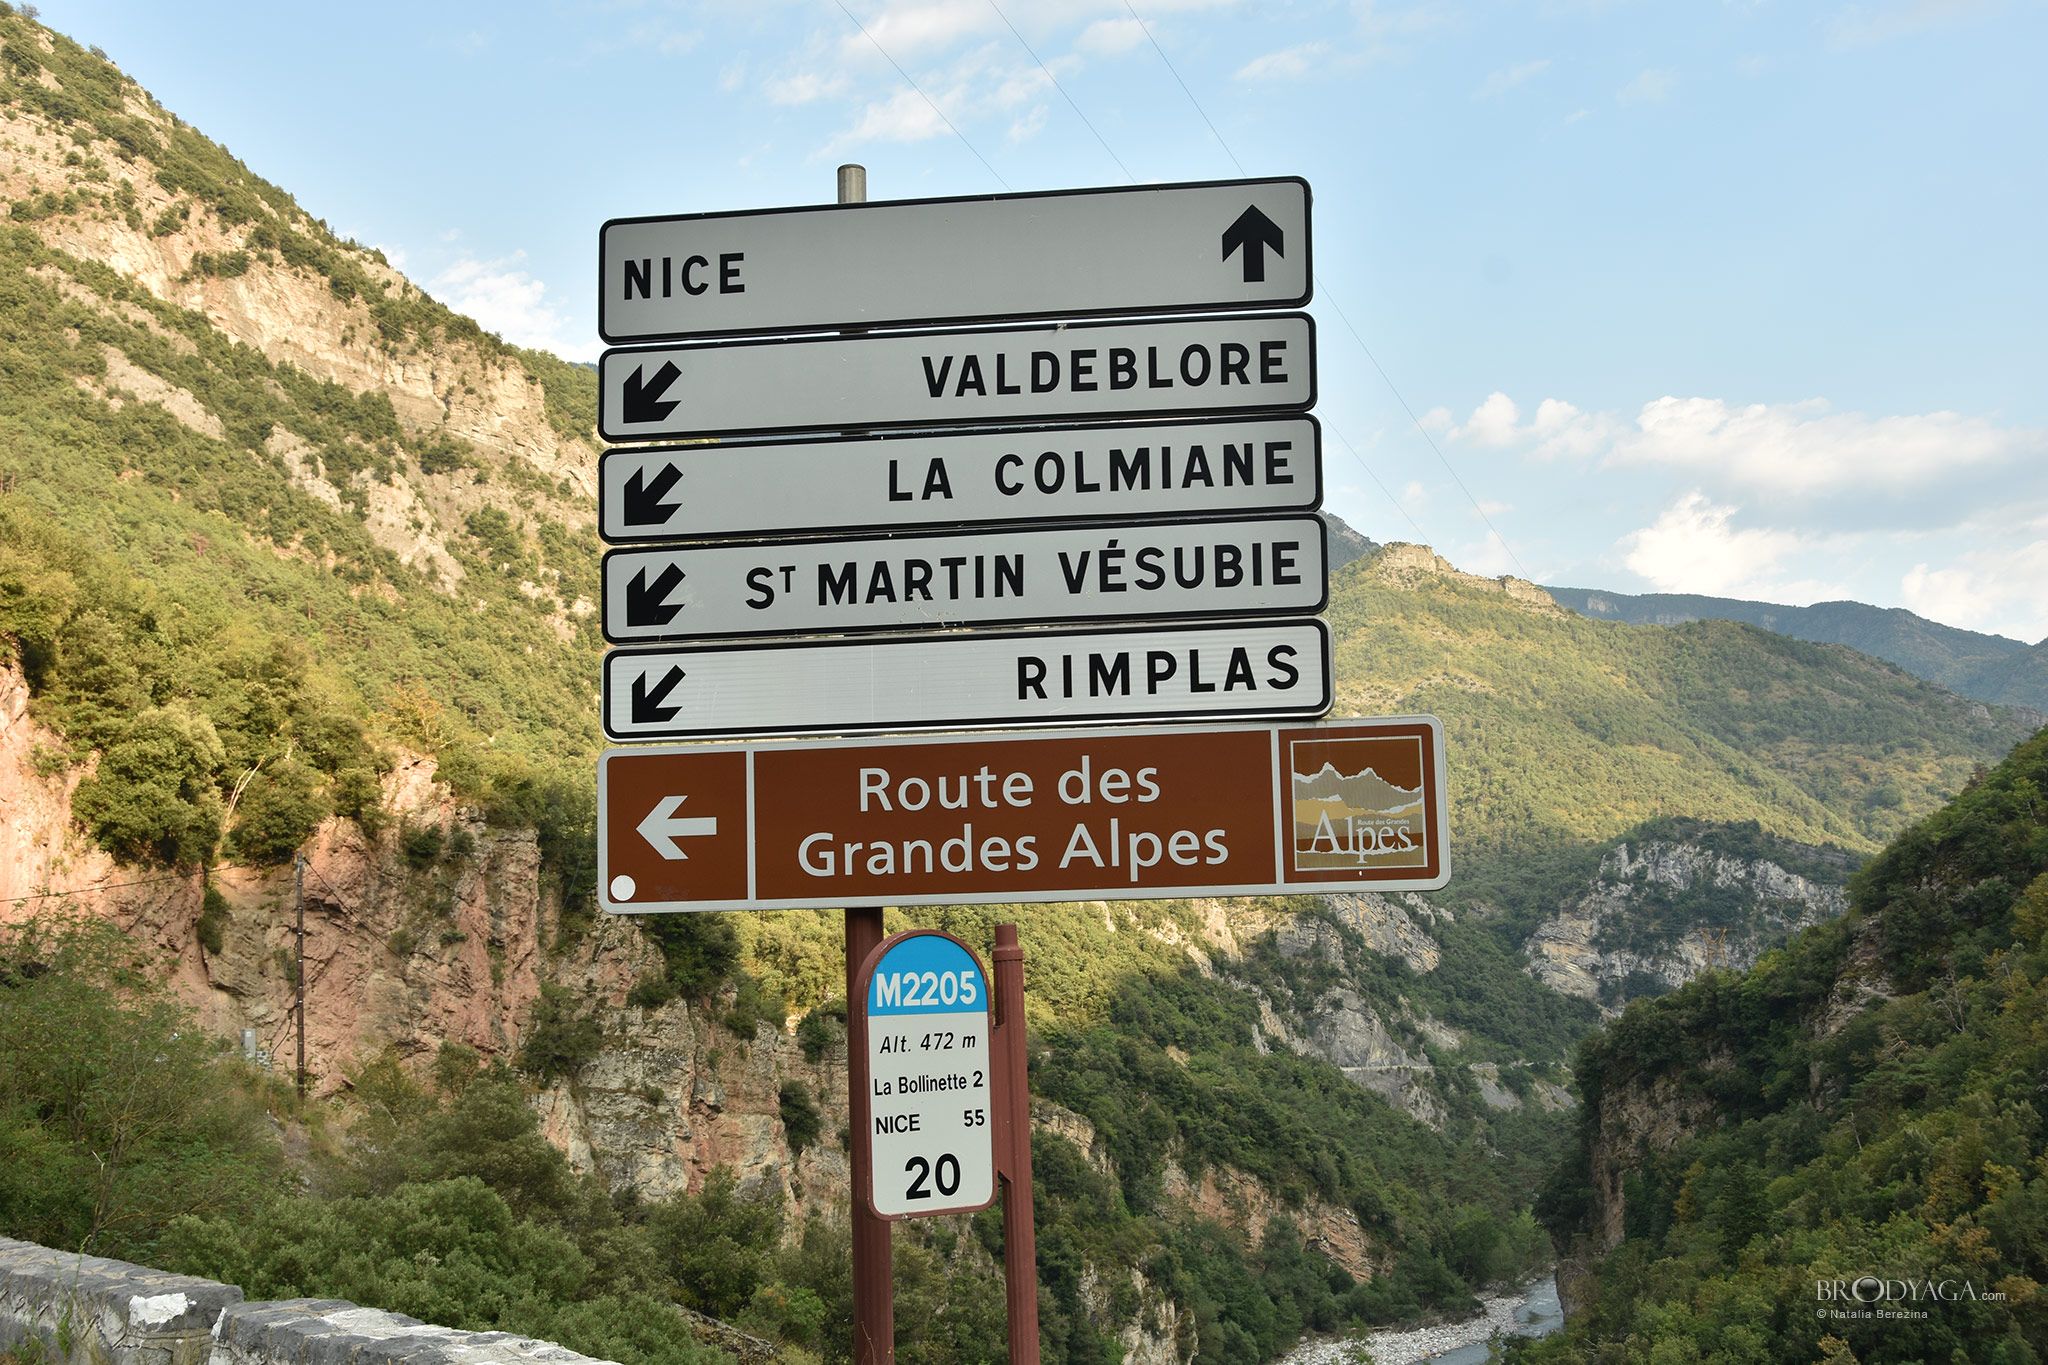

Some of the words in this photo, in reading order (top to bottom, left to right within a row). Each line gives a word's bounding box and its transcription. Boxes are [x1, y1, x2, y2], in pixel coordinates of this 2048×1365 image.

[624, 252, 746, 301] NICE
[922, 340, 1289, 398] VALDEBLORE
[889, 457, 953, 502] LA
[994, 441, 1294, 497] COLMIANE
[818, 552, 1025, 606] MARTIN
[1058, 539, 1302, 594] VÉSUBIE
[1018, 645, 1300, 701] RIMPLAS
[859, 766, 1033, 813] Route
[1057, 756, 1161, 804] des
[798, 823, 1037, 878] Grandes
[1058, 817, 1229, 883] Alpes
[1310, 809, 1412, 864] Alpes
[876, 971, 977, 1008] M2205
[880, 1036, 912, 1054] Alt.
[920, 1032, 954, 1051] 472
[962, 1035, 976, 1049] m
[874, 1078, 892, 1096] La
[898, 1073, 968, 1095] Bollinette
[972, 1070, 984, 1088] 2
[875, 1113, 921, 1135] NICE
[963, 1109, 985, 1127] 55
[905, 1153, 961, 1200] 20
